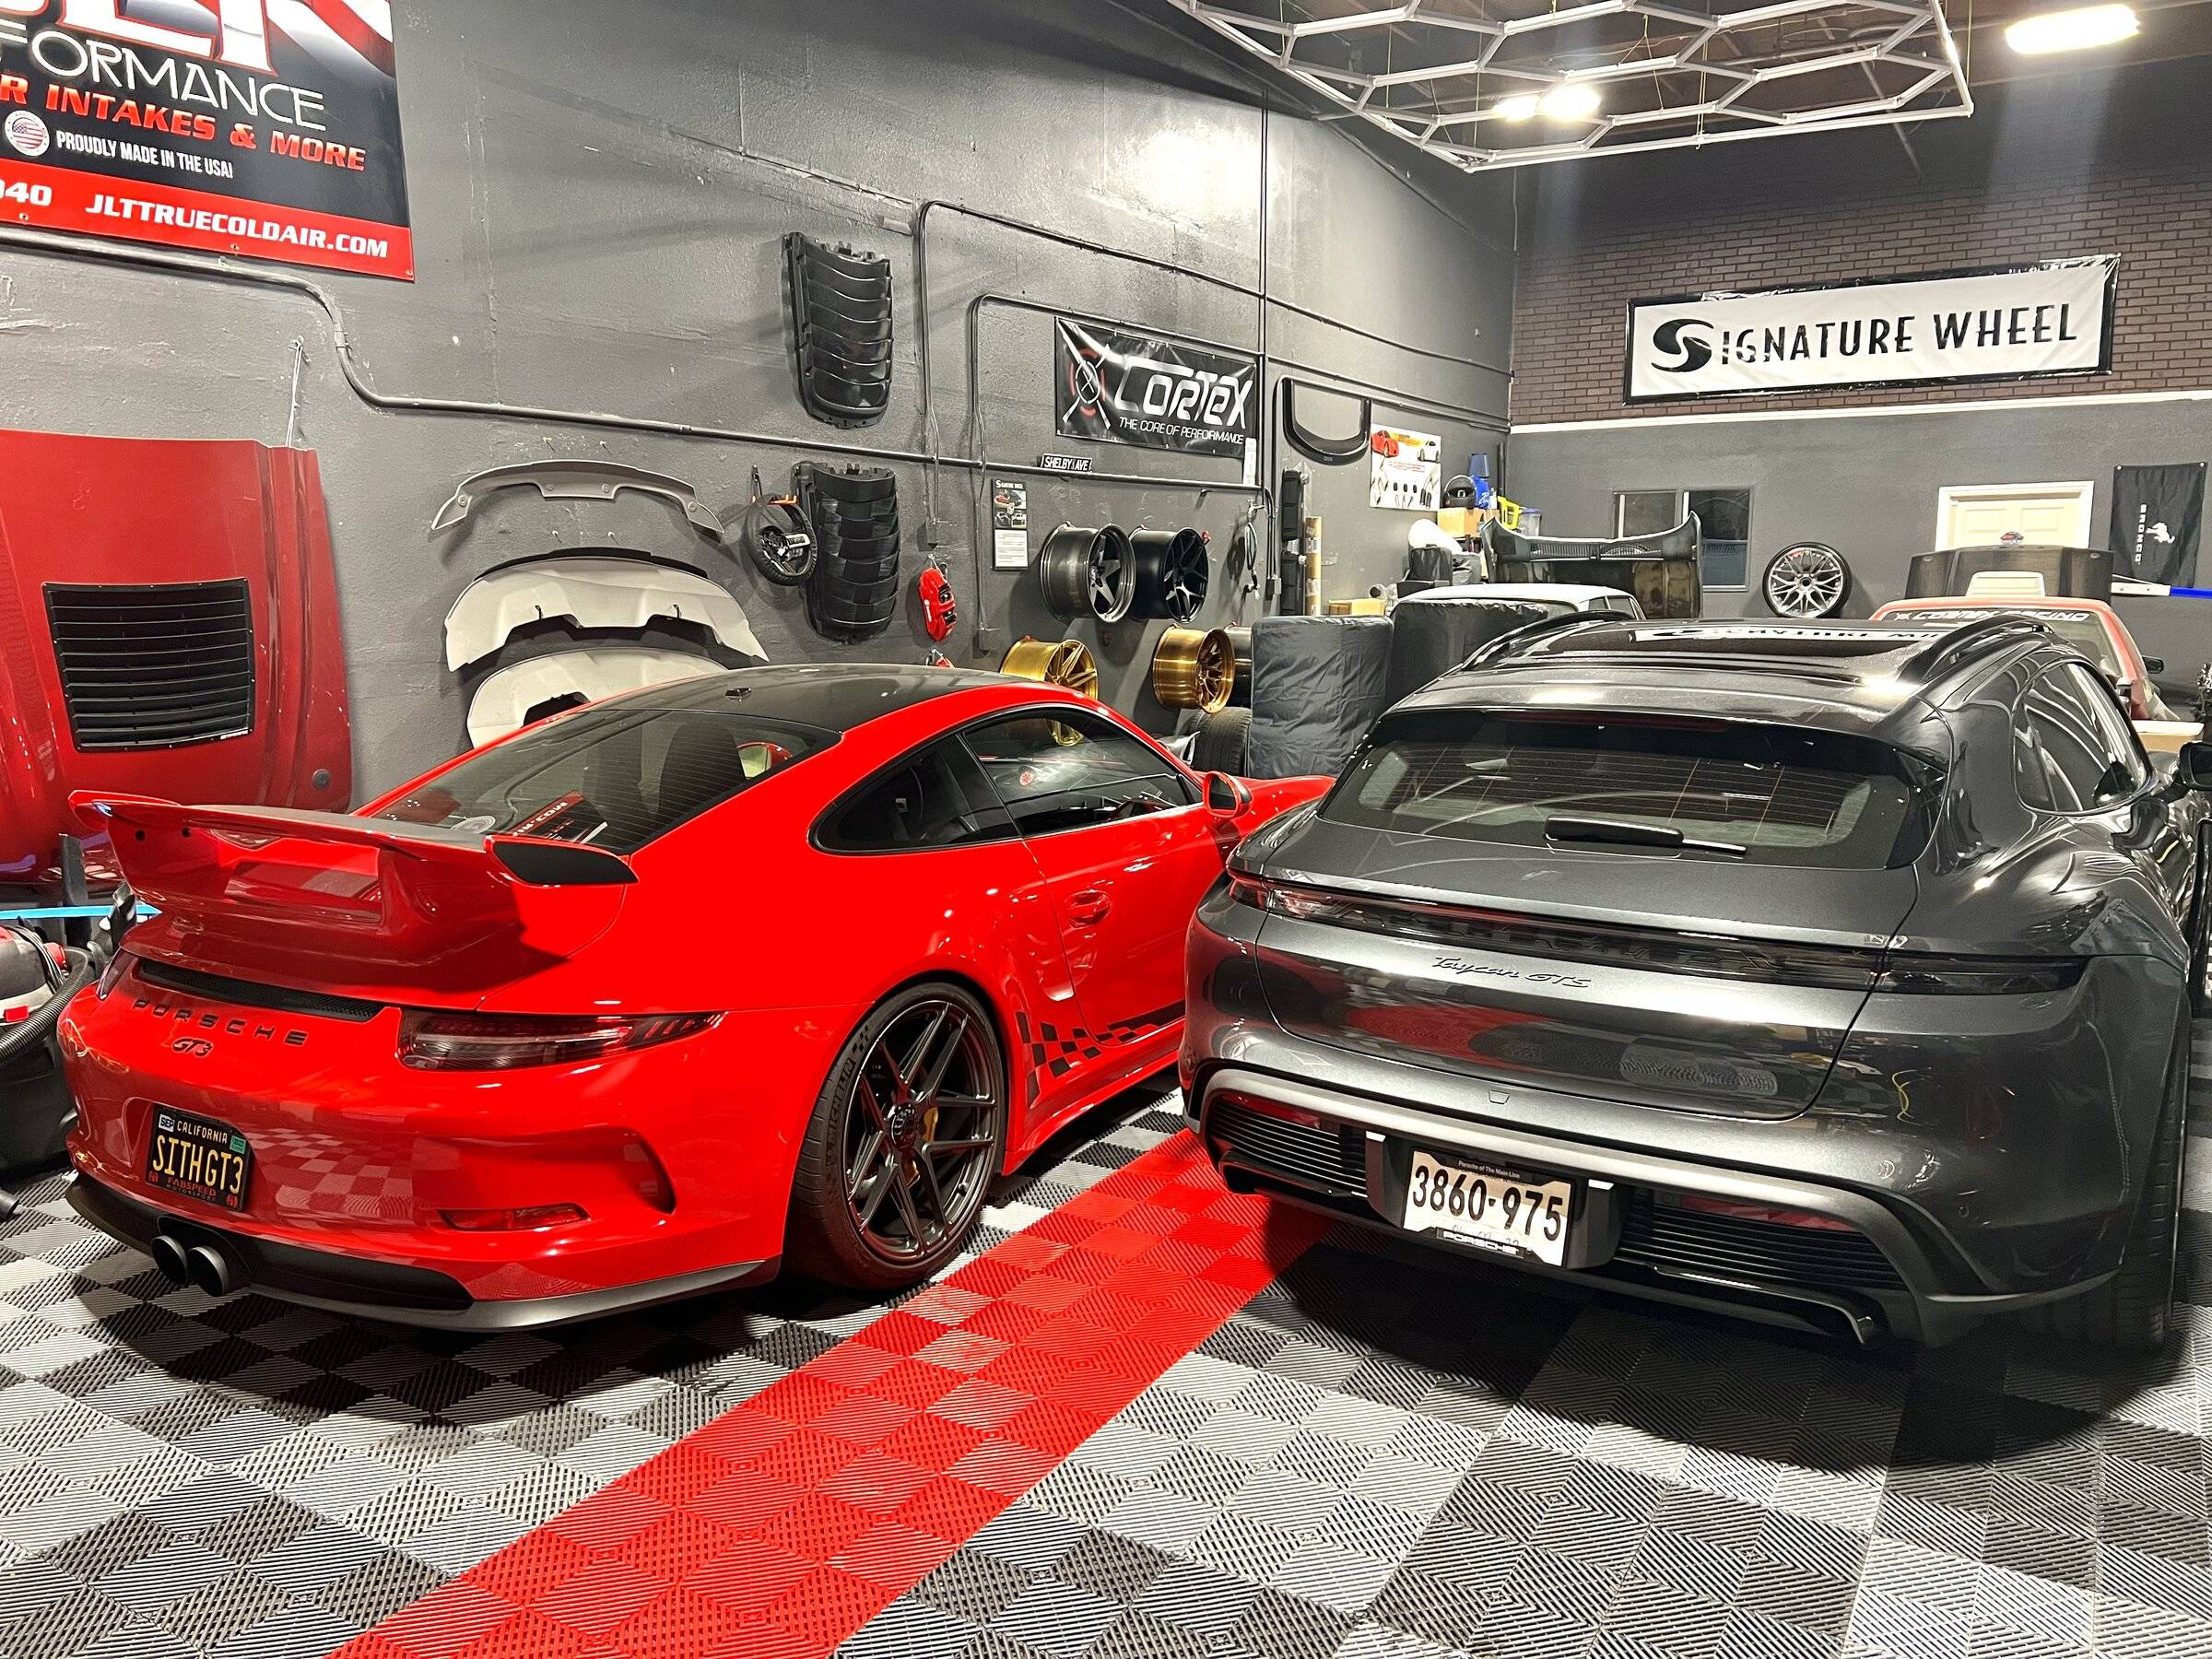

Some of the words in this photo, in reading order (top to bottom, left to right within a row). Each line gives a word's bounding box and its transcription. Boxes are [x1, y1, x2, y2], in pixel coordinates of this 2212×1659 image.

[44, 84, 216, 141] INTAKES
[229, 124, 257, 150] &
[269, 130, 366, 171] MORE
[55, 130, 117, 158] PROUDLY
[120, 141, 159, 165] MADE
[160, 149, 175, 169] IN
[176, 152, 203, 173] THE
[204, 158, 234, 179] USA!
[0, 179, 53, 206] 40
[85, 194, 388, 258] JLTTRUECOLDAIR.COM
[1935, 302, 2077, 351] WHEEL
[1119, 417, 1138, 430] THE
[1140, 420, 1165, 434] CORE
[1166, 424, 1180, 436] OF
[1180, 427, 1244, 444] PERFORMANCE
[1044, 456, 1073, 470] SHELBY
[1075, 459, 1089, 471] AVE
[2135, 504, 2147, 562] BRONCO
[1432, 957, 1519, 977] Taycan
[1524, 973, 1592, 988] GTS
[133, 998, 309, 1047] PORSCHE
[172, 1037, 213, 1057] GT3
[160, 1117, 174, 1128] SEP
[177, 1121, 228, 1145] CALIFORNIA
[152, 1135, 243, 1194] SITHGT3
[167, 1176, 217, 1196] FABSPEED
[1442, 1230, 1520, 1255] PORSCHE
